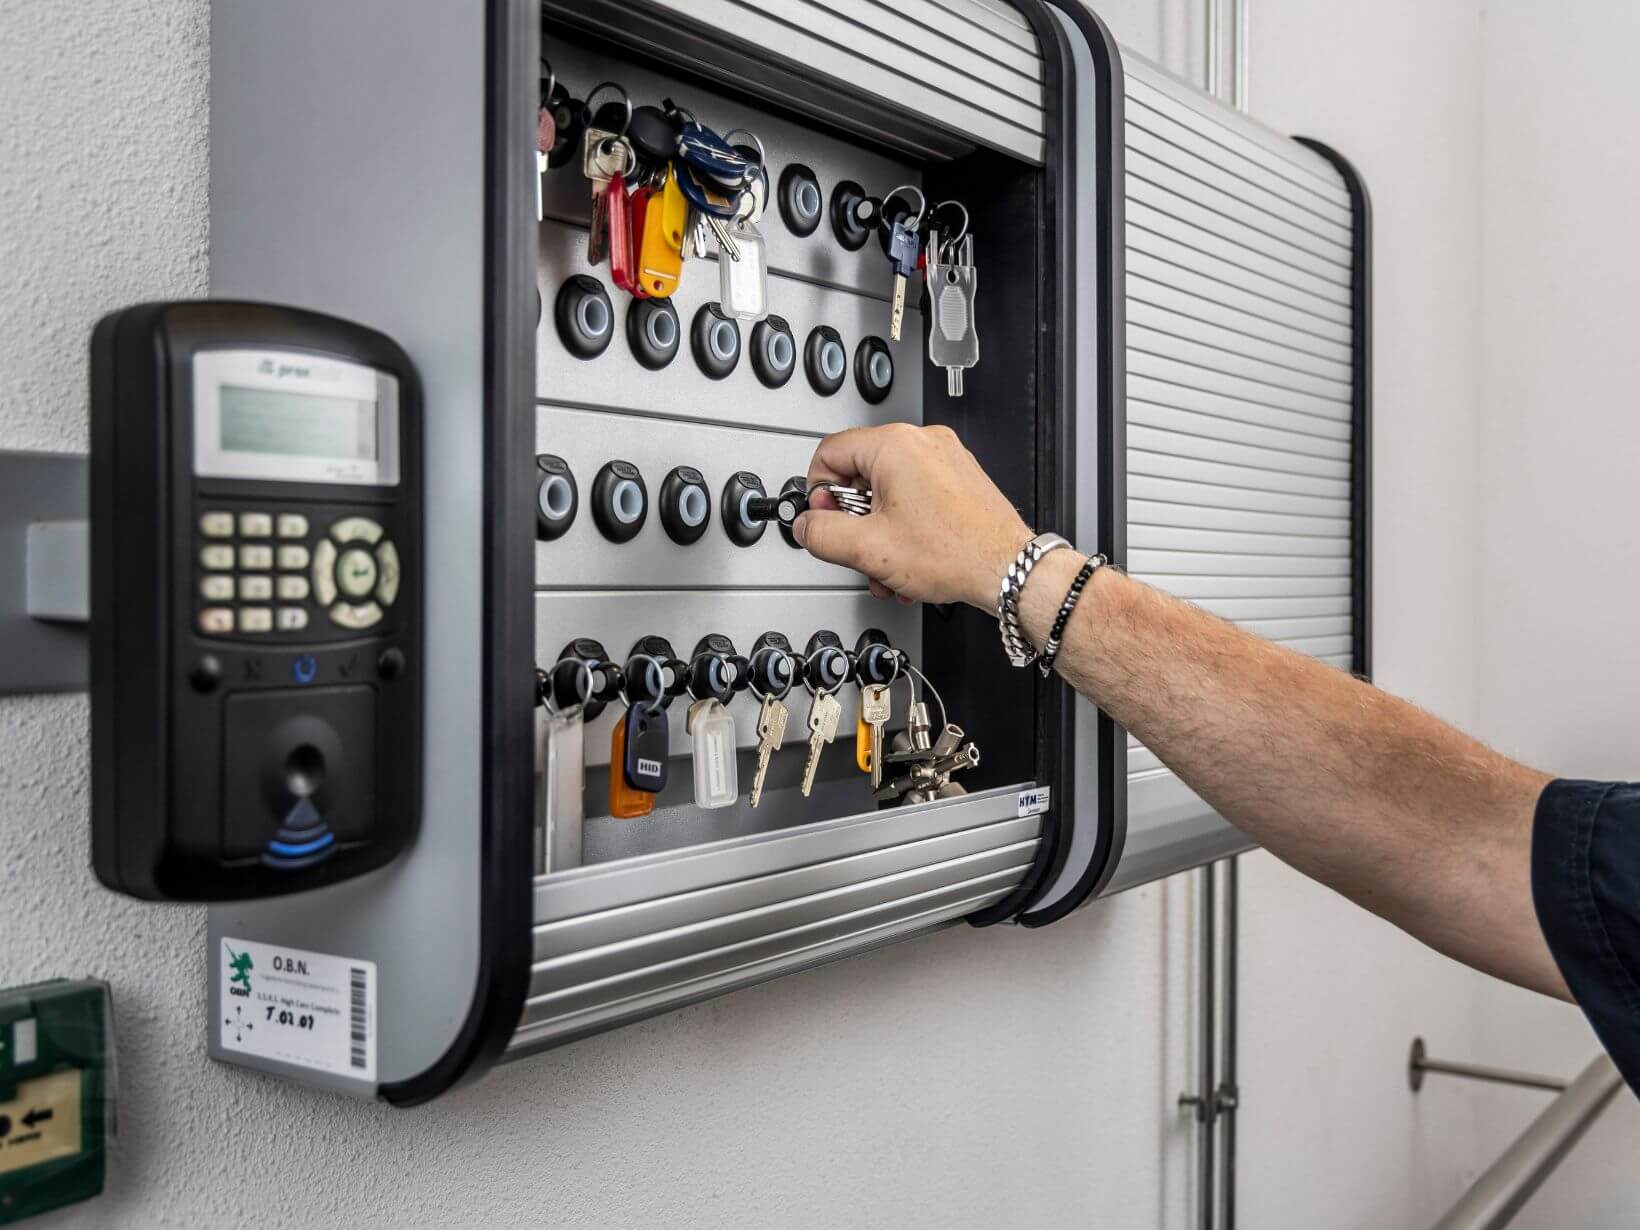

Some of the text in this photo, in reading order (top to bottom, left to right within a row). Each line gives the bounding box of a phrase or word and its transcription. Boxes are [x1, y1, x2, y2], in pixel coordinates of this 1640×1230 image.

[640, 761, 659, 773] HID
[1019, 794, 1037, 808] HTM
[273, 956, 310, 976] O.B.N.
